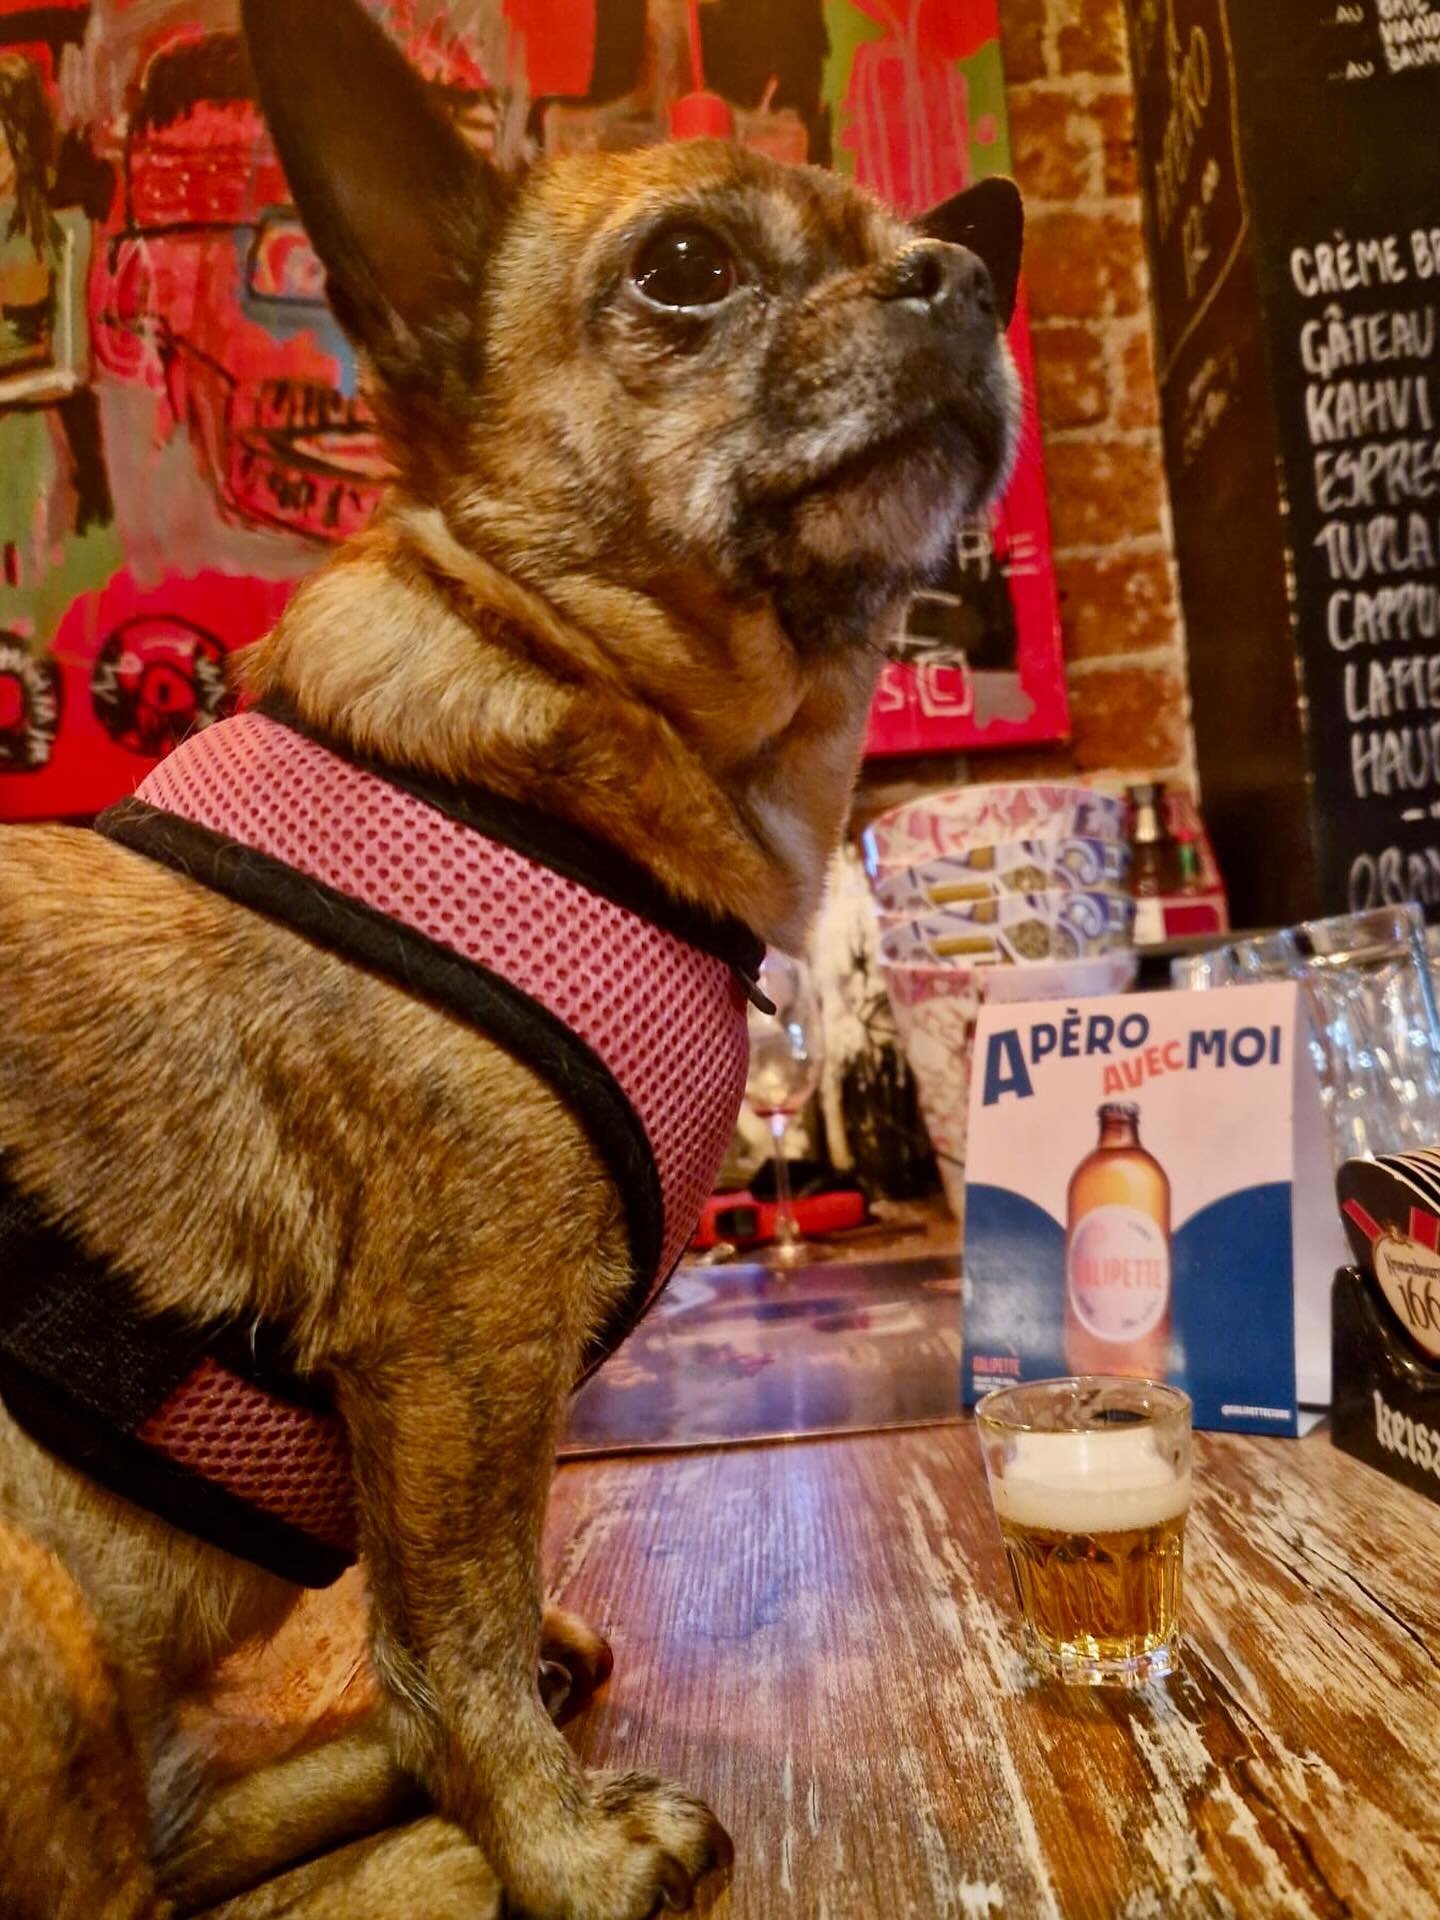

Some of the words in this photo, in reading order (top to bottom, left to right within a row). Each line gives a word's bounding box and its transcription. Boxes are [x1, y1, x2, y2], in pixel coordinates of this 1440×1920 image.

[1290, 228, 1407, 297] CRÈME
[1301, 302, 1434, 380] GÂTEAU
[1306, 377, 1433, 444] KAHVI
[1102, 1040, 1185, 1097] AVEC
[1187, 1025, 1282, 1070] MOI
